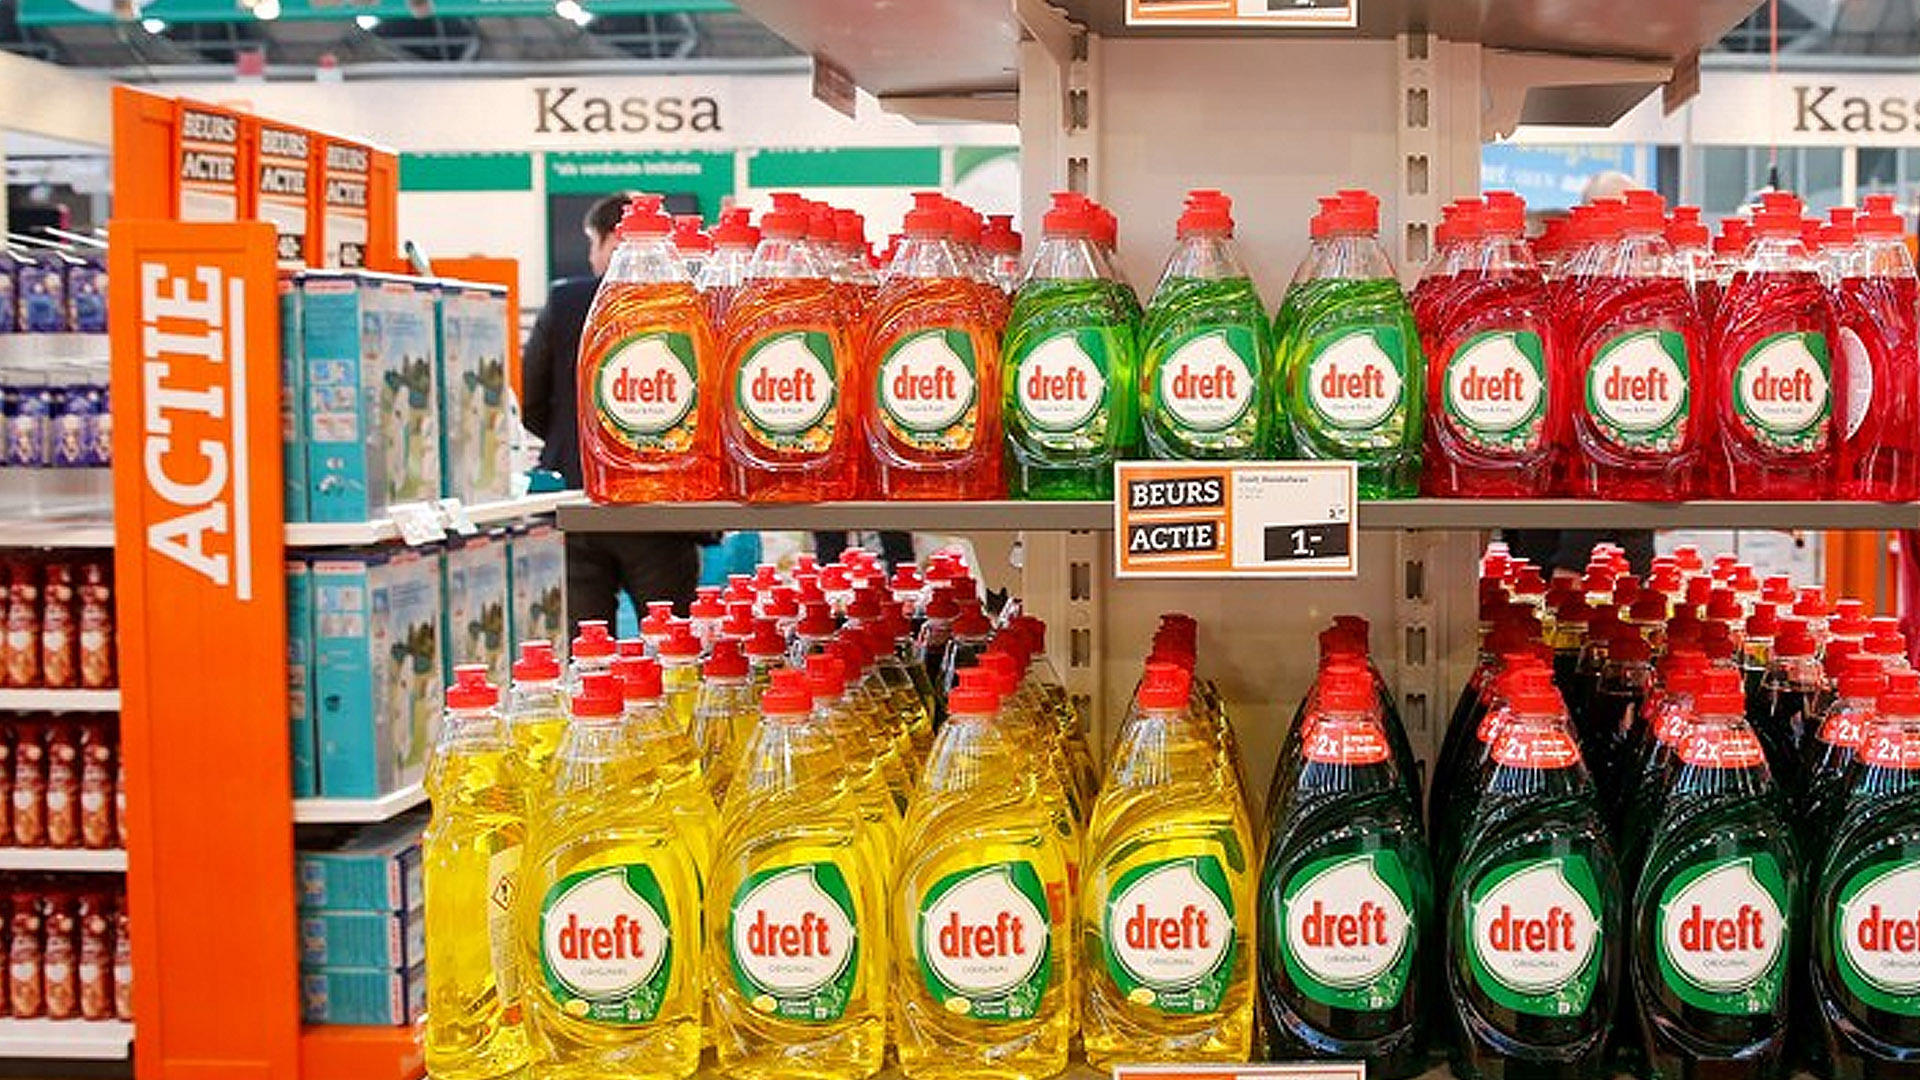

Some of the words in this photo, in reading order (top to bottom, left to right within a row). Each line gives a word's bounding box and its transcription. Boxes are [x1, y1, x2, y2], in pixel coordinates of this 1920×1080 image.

[533, 86, 722, 133] Kassa
[1793, 85, 1920, 133] Kas
[612, 368, 677, 403] dreft
[751, 367, 815, 402] dreft
[893, 366, 956, 399] dreft
[1027, 366, 1086, 400] dreft
[1172, 365, 1235, 399] dreft
[1321, 365, 1384, 398] dreft
[1460, 367, 1524, 401] dreft
[1604, 366, 1669, 402] dreft
[1752, 366, 1814, 402] dreft
[141, 262, 230, 586] ACTIE
[1132, 481, 1220, 507] BEURS
[1316, 734, 1338, 756] 2x
[1838, 720, 1859, 742] 2x
[1505, 740, 1527, 761] 2x
[1695, 738, 1718, 760] 2x
[1877, 738, 1900, 761] 2x
[558, 913, 645, 960] dreft
[746, 910, 831, 957] dreft
[938, 910, 1026, 958] dreft
[1125, 903, 1210, 949] dreft
[1301, 901, 1389, 947] dreft
[1488, 905, 1576, 953] dreft
[1678, 904, 1767, 952] dreft
[1857, 904, 1920, 954] dre
